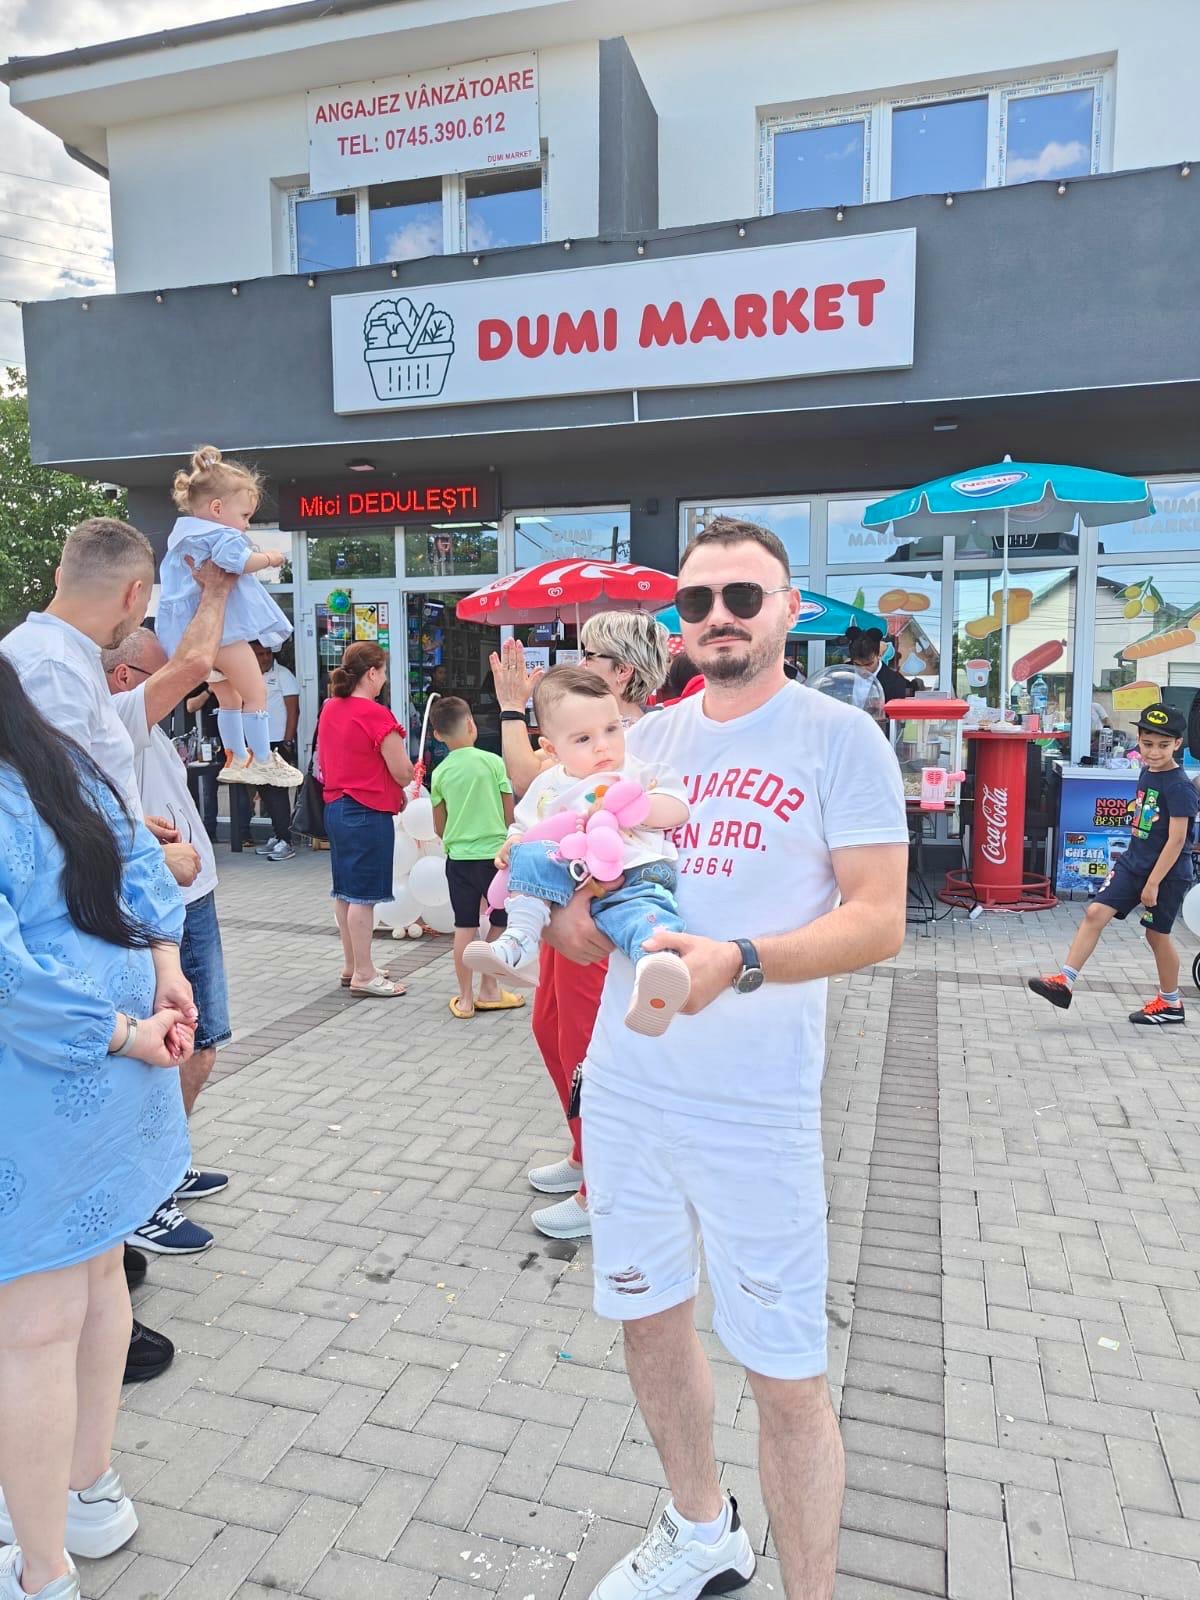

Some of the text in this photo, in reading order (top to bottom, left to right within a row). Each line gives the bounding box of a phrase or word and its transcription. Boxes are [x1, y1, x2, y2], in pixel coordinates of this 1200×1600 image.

[315, 68, 534, 124] ANGAJEZ VÂNZĂTOARE
[337, 112, 505, 156] TEL: 0745.390.612
[487, 149, 532, 163] DUMI MARKET
[478, 278, 886, 362] DUMI MARKET
[300, 496, 341, 517] Mici
[682, 767, 806, 823] UARED2
[1096, 799, 1127, 808] NON
[982, 783, 1008, 865] Coca-Cola
[1095, 815, 1123, 826] BEST
[1096, 807, 1127, 816] STOP
[707, 820, 767, 852] BRO.
[681, 857, 734, 877] 1964
